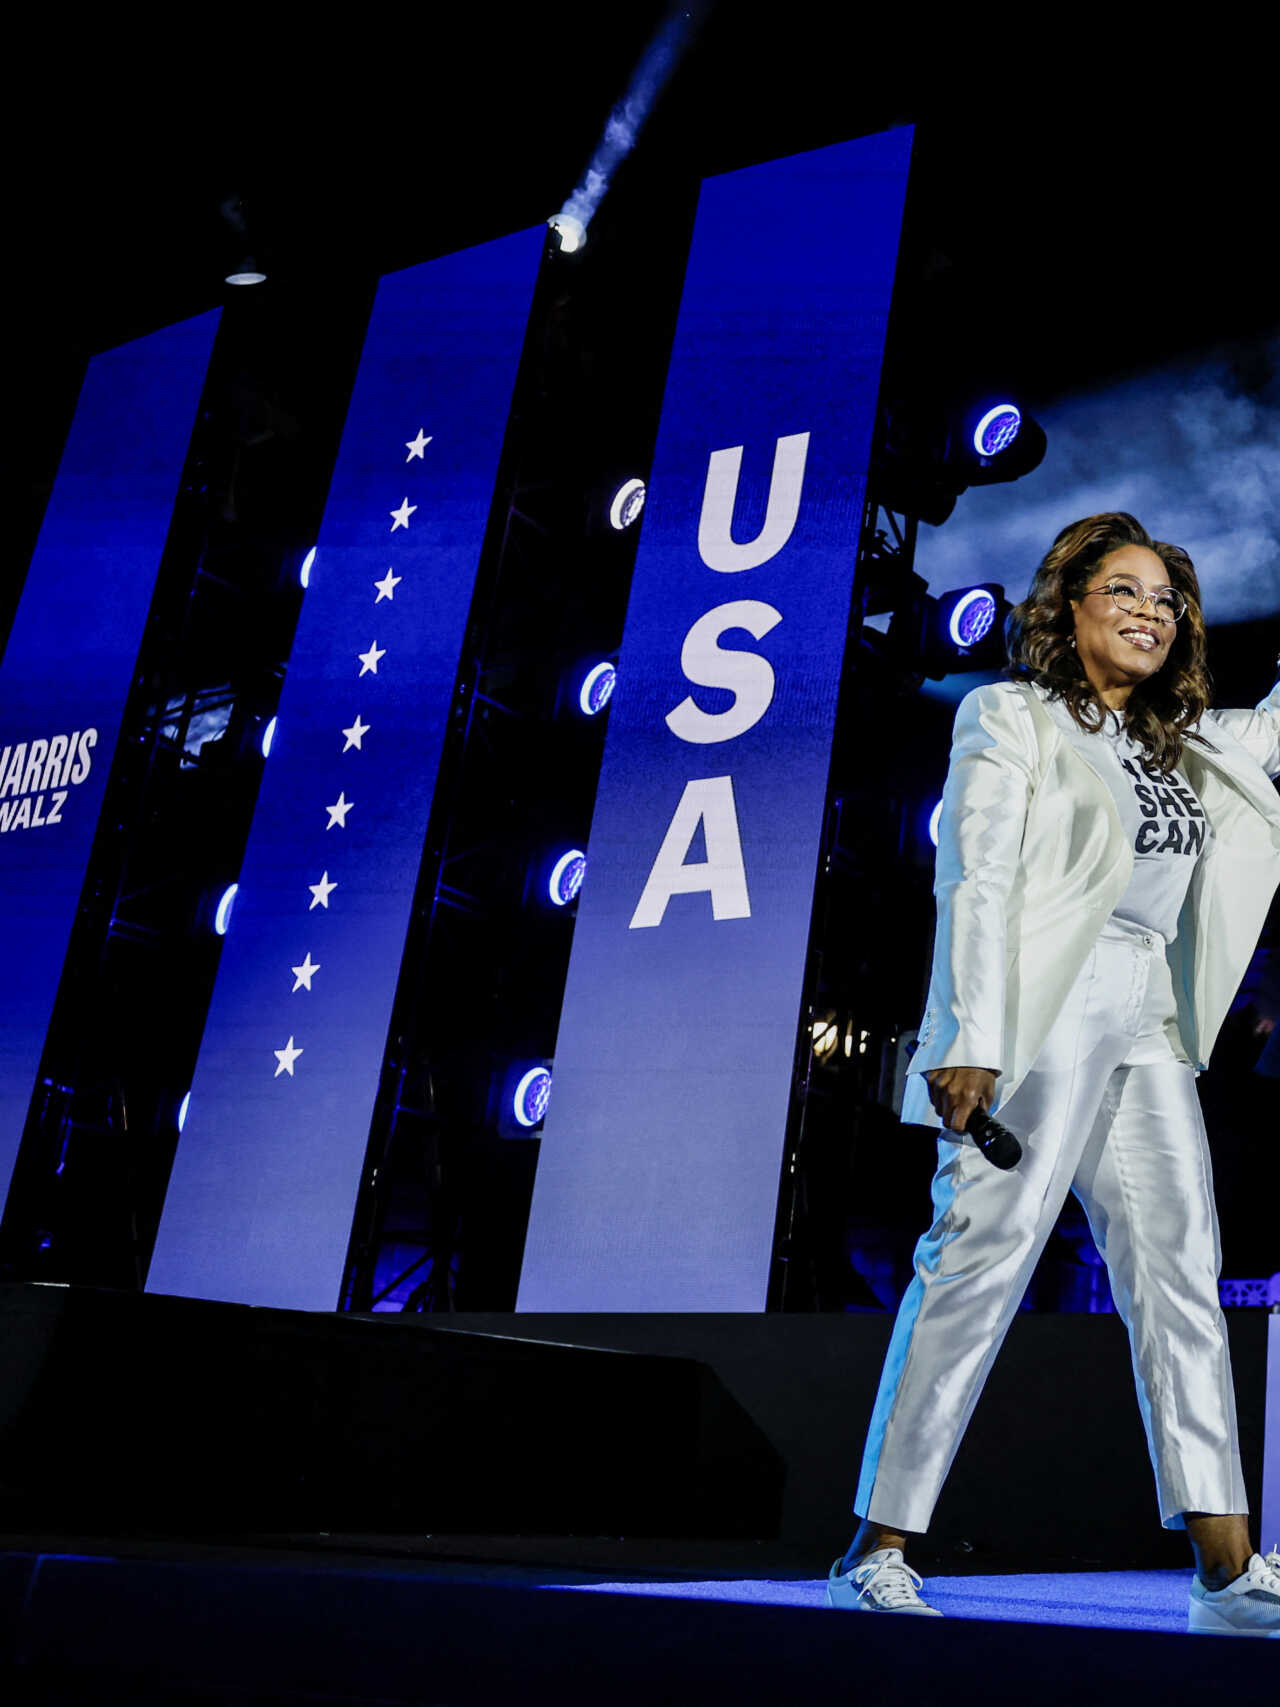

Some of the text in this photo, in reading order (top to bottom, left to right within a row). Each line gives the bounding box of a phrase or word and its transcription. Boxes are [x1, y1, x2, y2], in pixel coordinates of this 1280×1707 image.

[629, 431, 811, 930] USA
[1134, 784, 1204, 818] SHE
[1135, 819, 1206, 857] CAN
